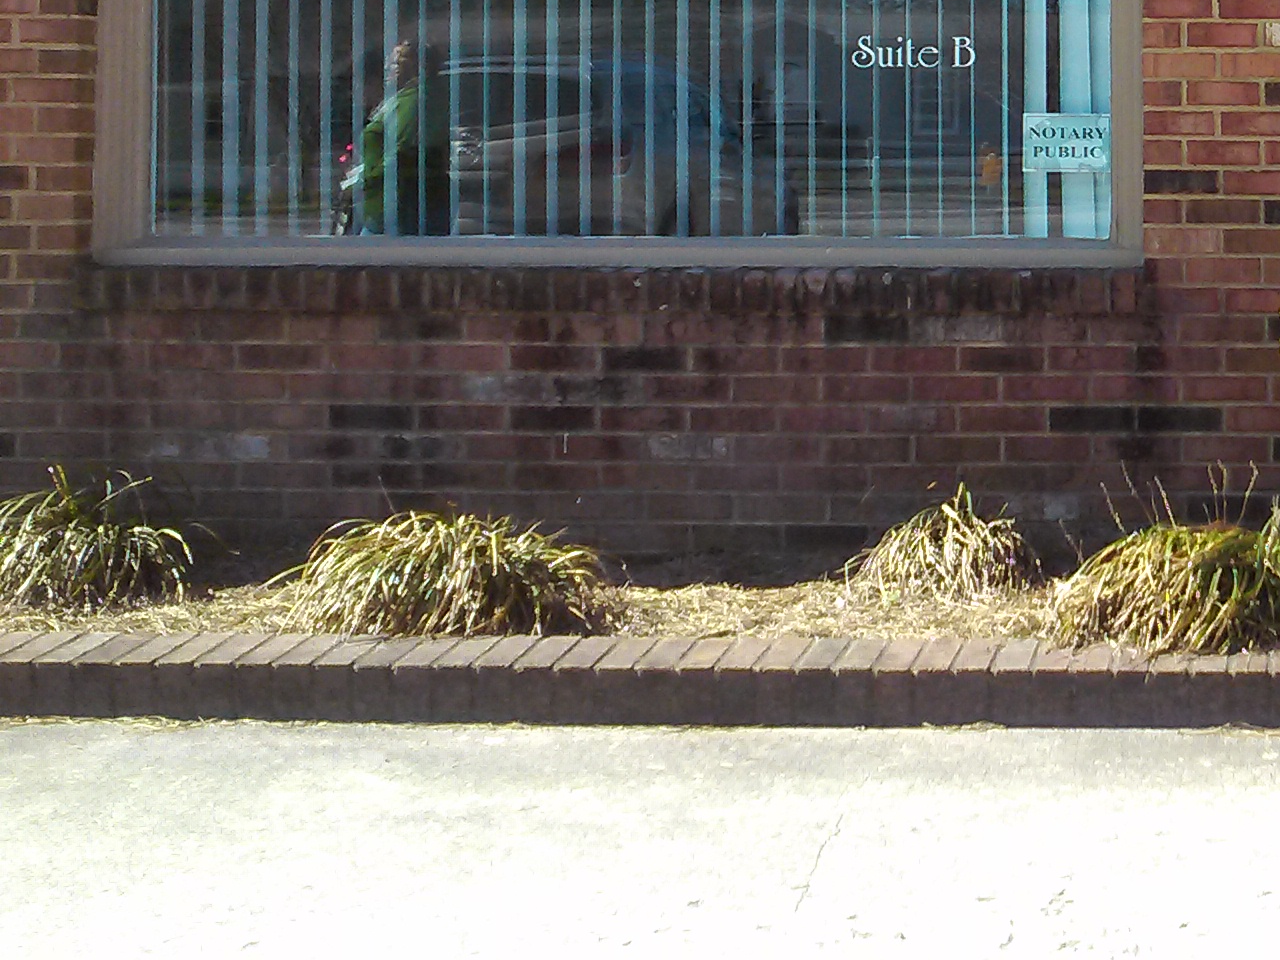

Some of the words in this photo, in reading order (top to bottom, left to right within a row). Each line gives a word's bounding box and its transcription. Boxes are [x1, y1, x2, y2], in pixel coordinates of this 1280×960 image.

[851, 34, 941, 69] Suite
[951, 35, 976, 68] B
[1028, 126, 1107, 140] NOTARY
[1032, 145, 1103, 159] PUBLIC
